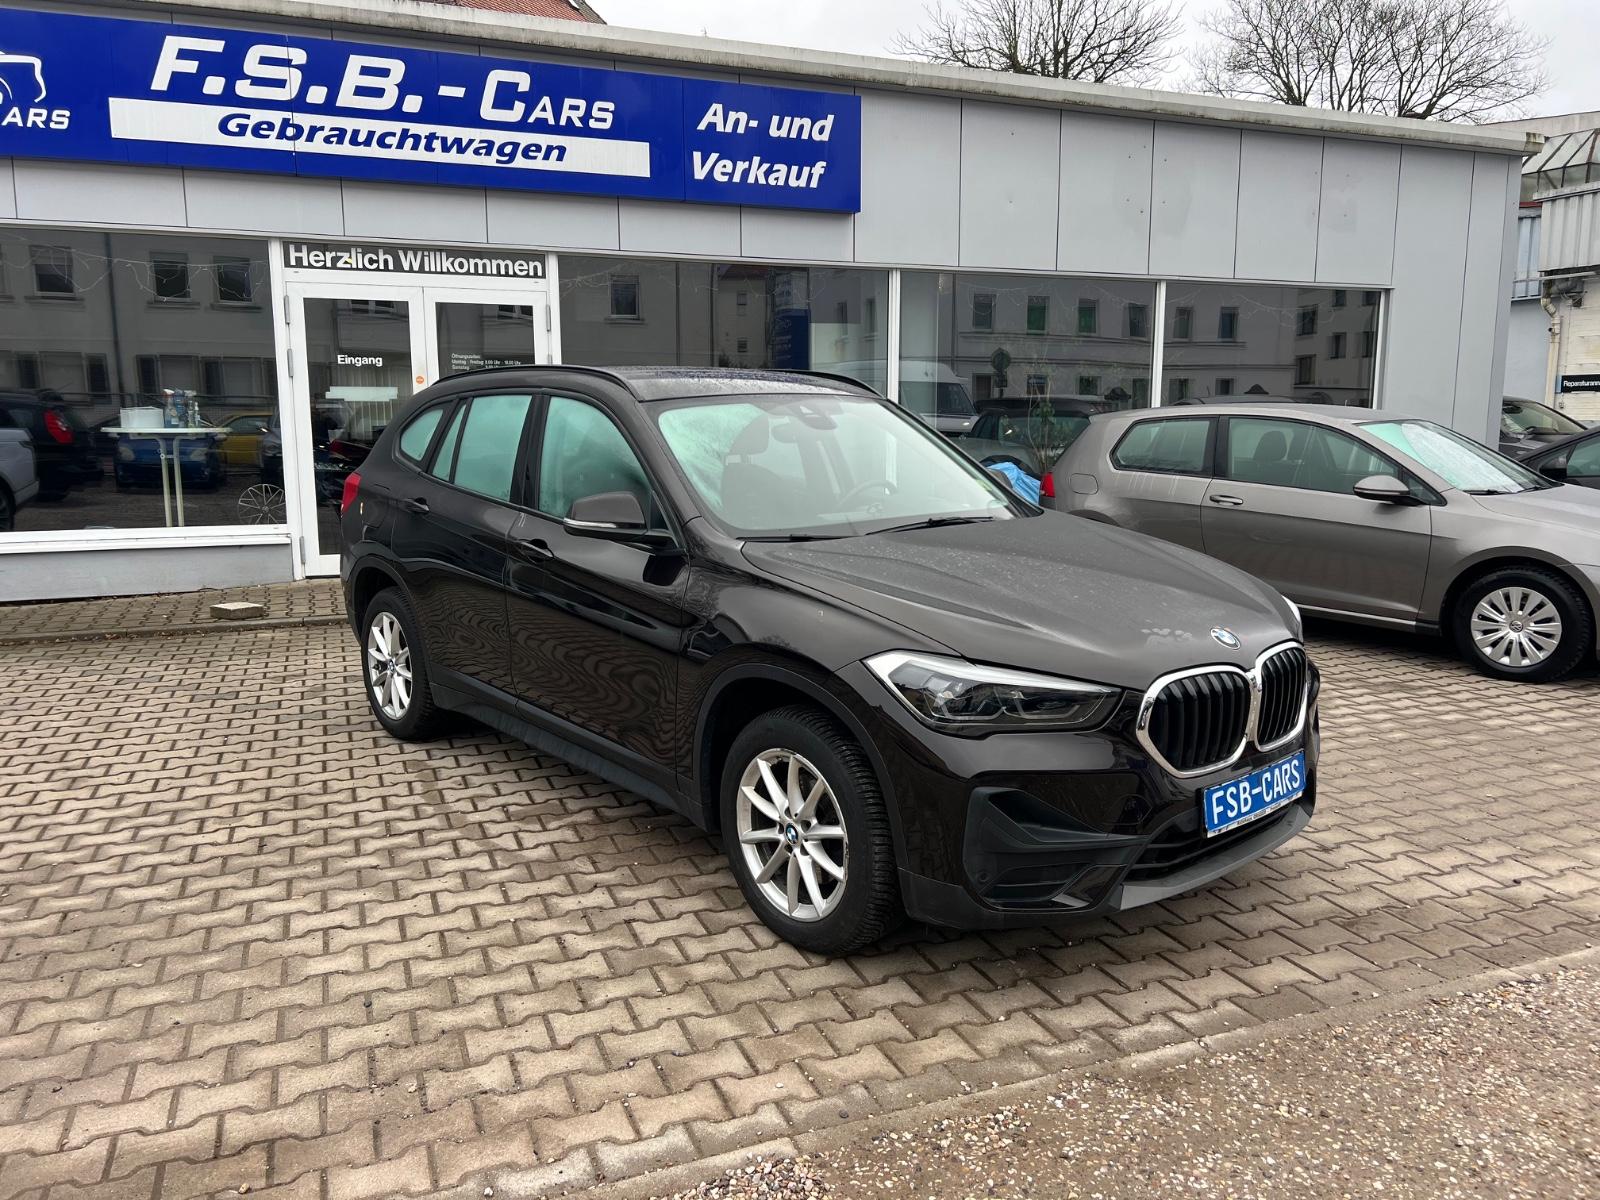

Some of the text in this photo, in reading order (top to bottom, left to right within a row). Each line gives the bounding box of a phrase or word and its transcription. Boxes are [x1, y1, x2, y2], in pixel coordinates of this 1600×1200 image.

[218, 113, 567, 165] Gebrauchtwagen
[697, 103, 834, 142] An- und
[693, 151, 826, 189] Verkauf
[289, 244, 543, 277] Herzlich Willkommen
[337, 354, 383, 367] Eingang
[1211, 759, 1300, 825] FSB-CARS
